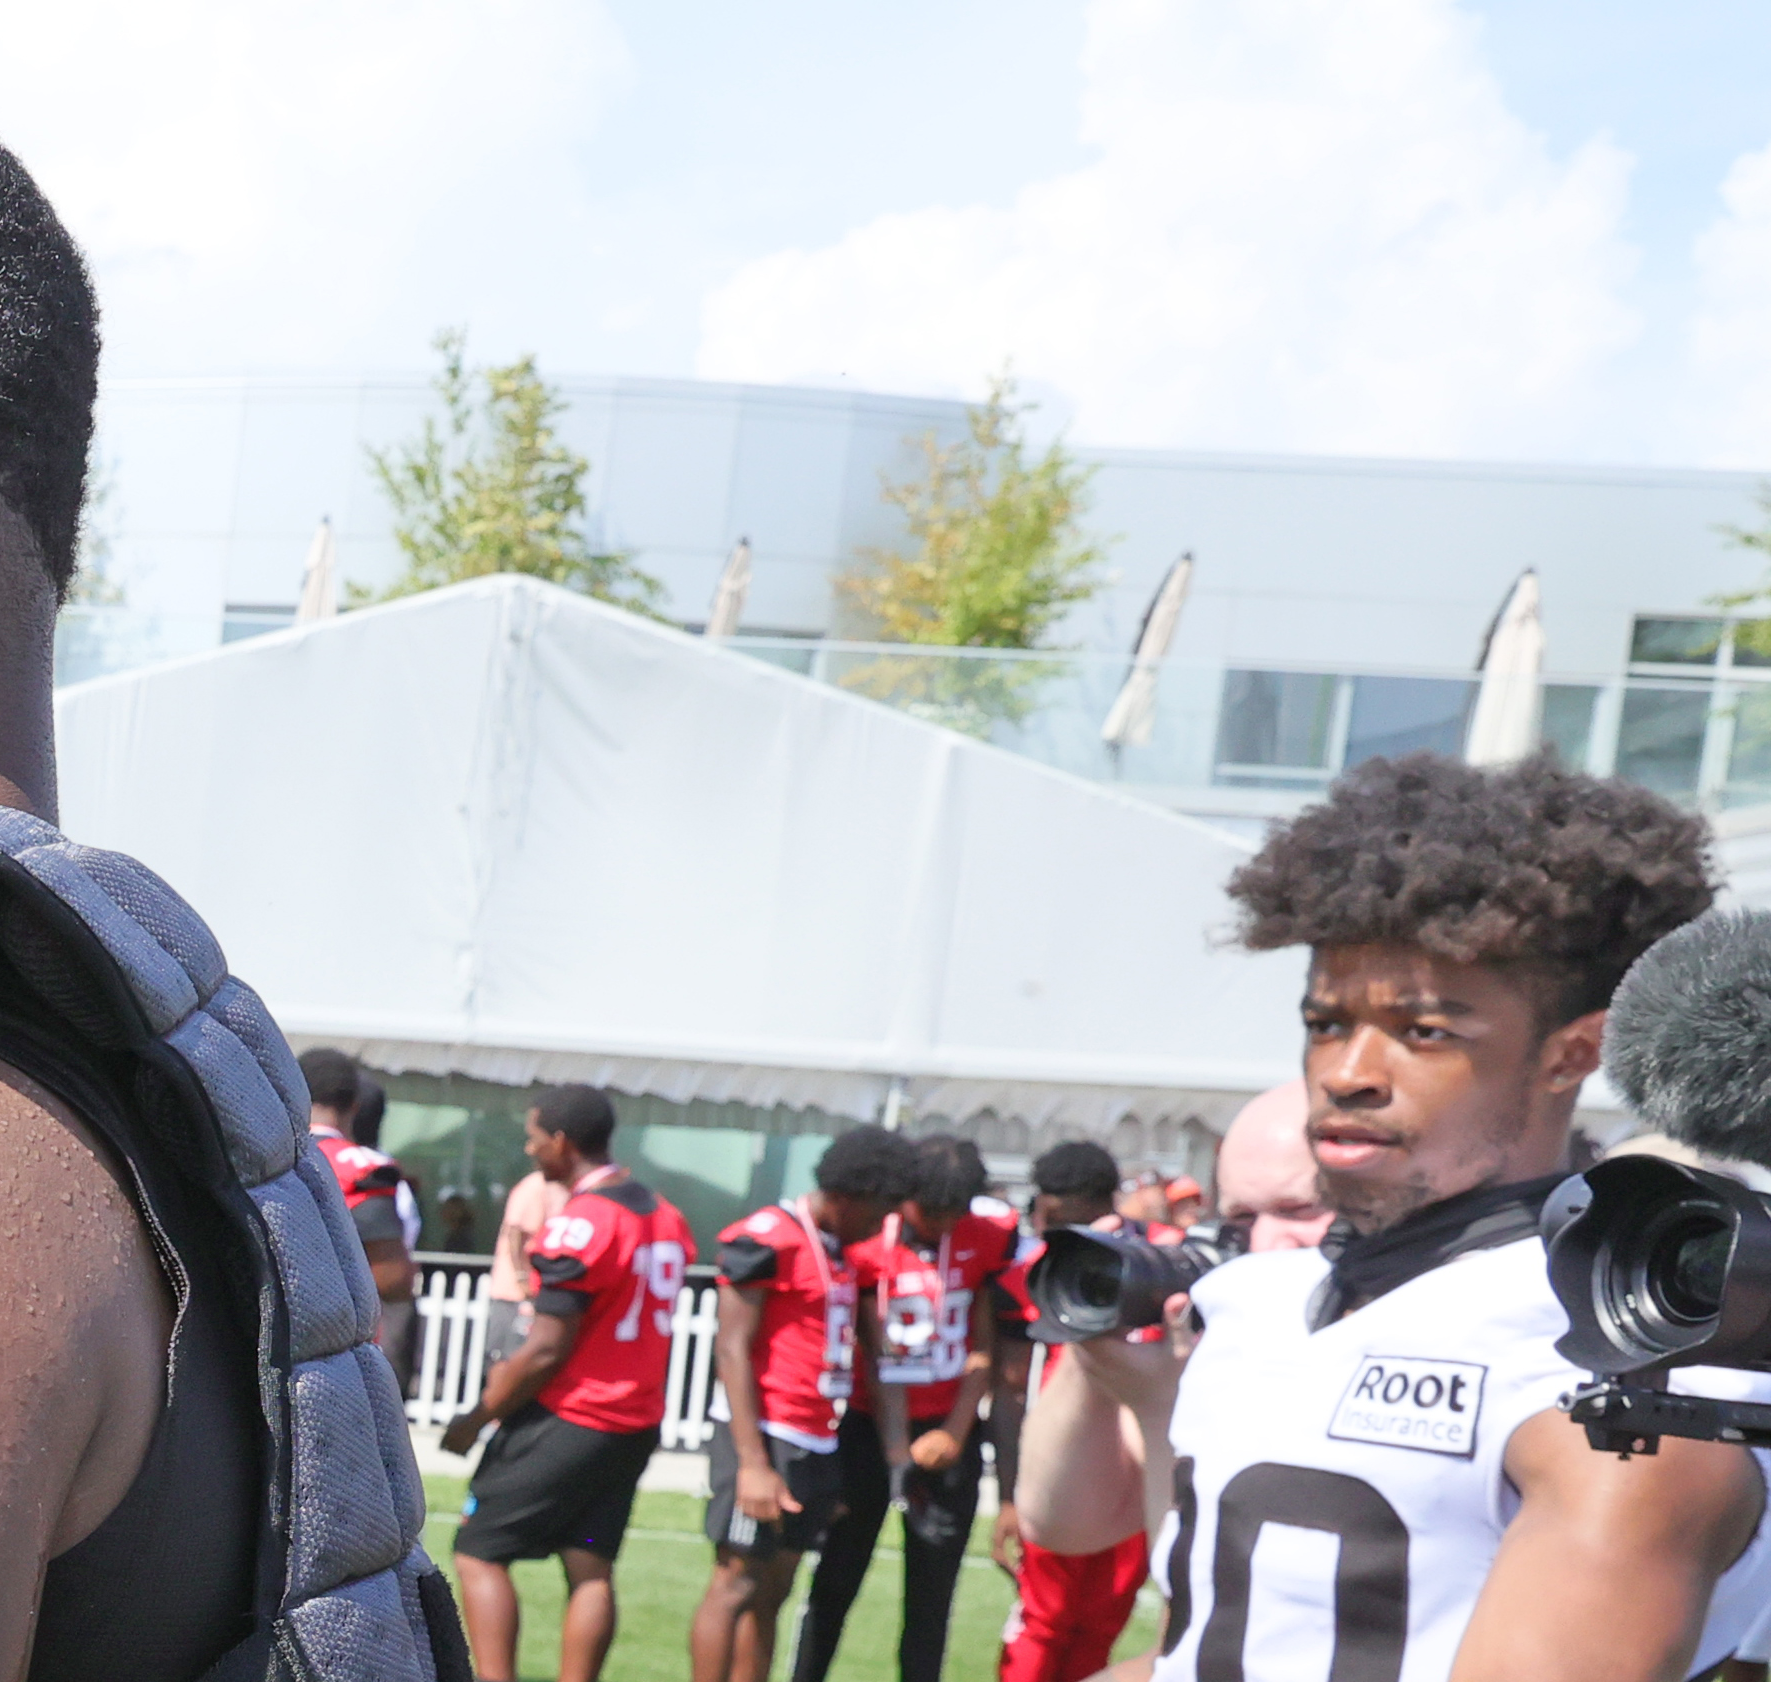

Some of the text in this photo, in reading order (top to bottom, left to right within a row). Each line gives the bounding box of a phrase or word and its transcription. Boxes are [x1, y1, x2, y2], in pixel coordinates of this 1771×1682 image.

[542, 1215, 595, 1251] 79
[614, 1240, 686, 1342] 79
[1354, 1365, 1466, 1413] Root
